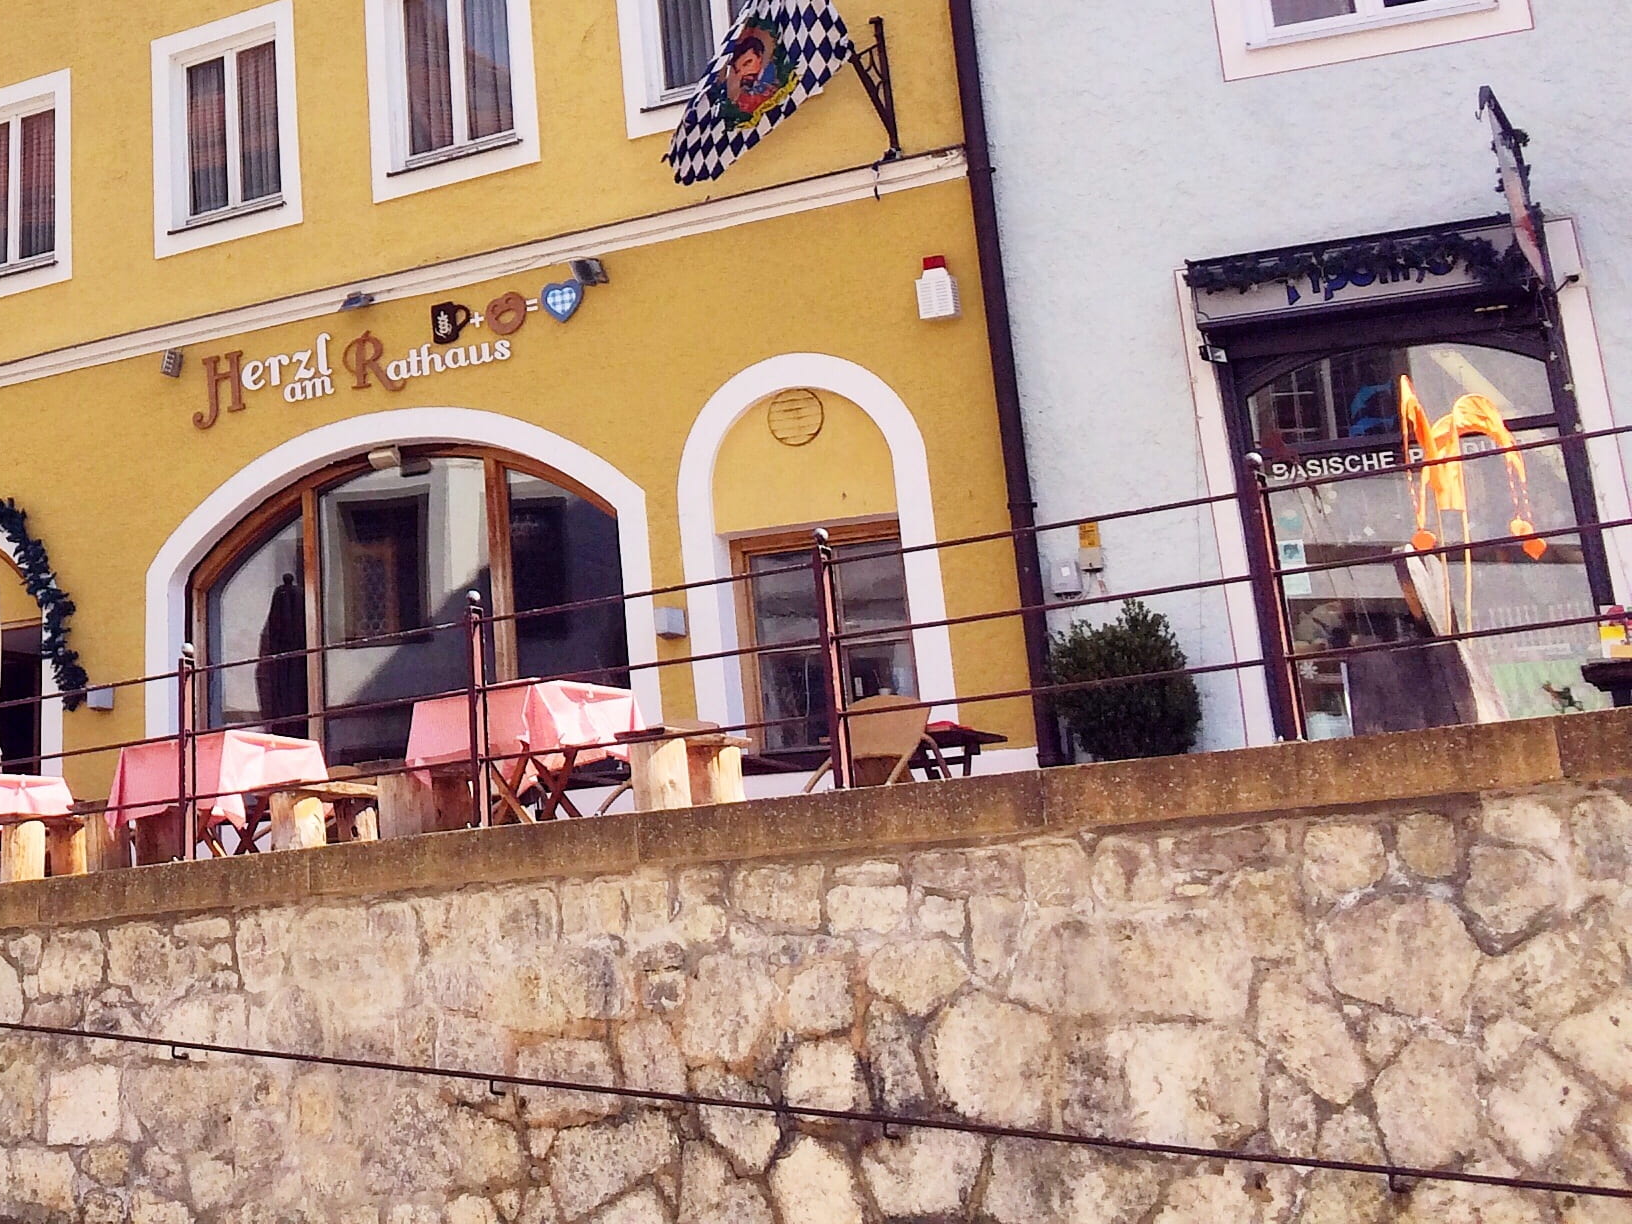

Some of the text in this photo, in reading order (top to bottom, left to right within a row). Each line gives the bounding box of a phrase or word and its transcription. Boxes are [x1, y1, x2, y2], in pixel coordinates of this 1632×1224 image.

[192, 330, 512, 430] Herzl am Rathaus
[1272, 450, 1397, 481] BASISCHE
